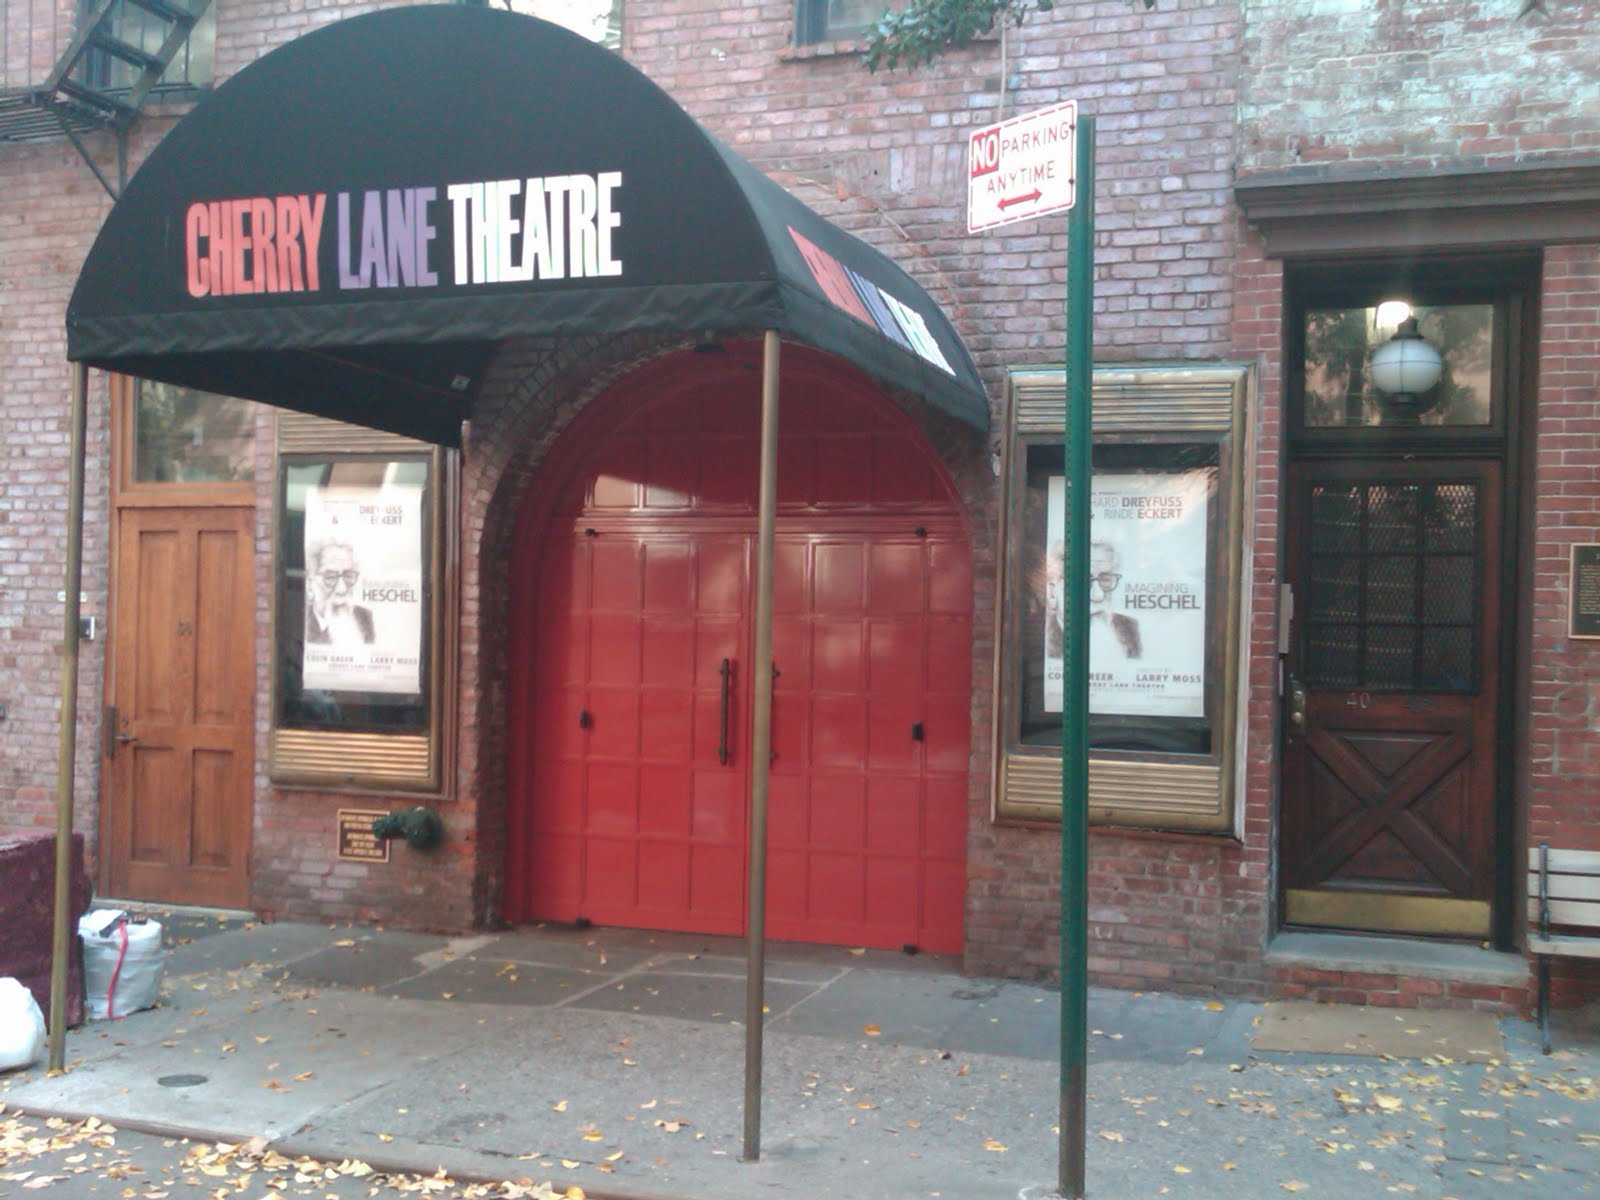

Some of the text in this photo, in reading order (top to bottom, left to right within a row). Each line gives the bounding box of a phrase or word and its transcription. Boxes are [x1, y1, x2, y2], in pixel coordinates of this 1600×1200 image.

[973, 121, 1069, 173] NO PARKING
[987, 160, 1055, 194] ANYTIME
[186, 171, 622, 298] CHERRY LANE THEATRE
[1091, 496, 1183, 508] HARD DREYFUSS
[359, 505, 403, 514] DREUSS
[1104, 508, 1183, 519] RINDE ECKERT
[1124, 583, 1189, 594] IMAGINING
[362, 588, 418, 602] HESCHEL
[1124, 594, 1201, 609] HESCHEL
[1089, 673, 1114, 681] REER
[1136, 674, 1201, 683] LARRY MOSS
